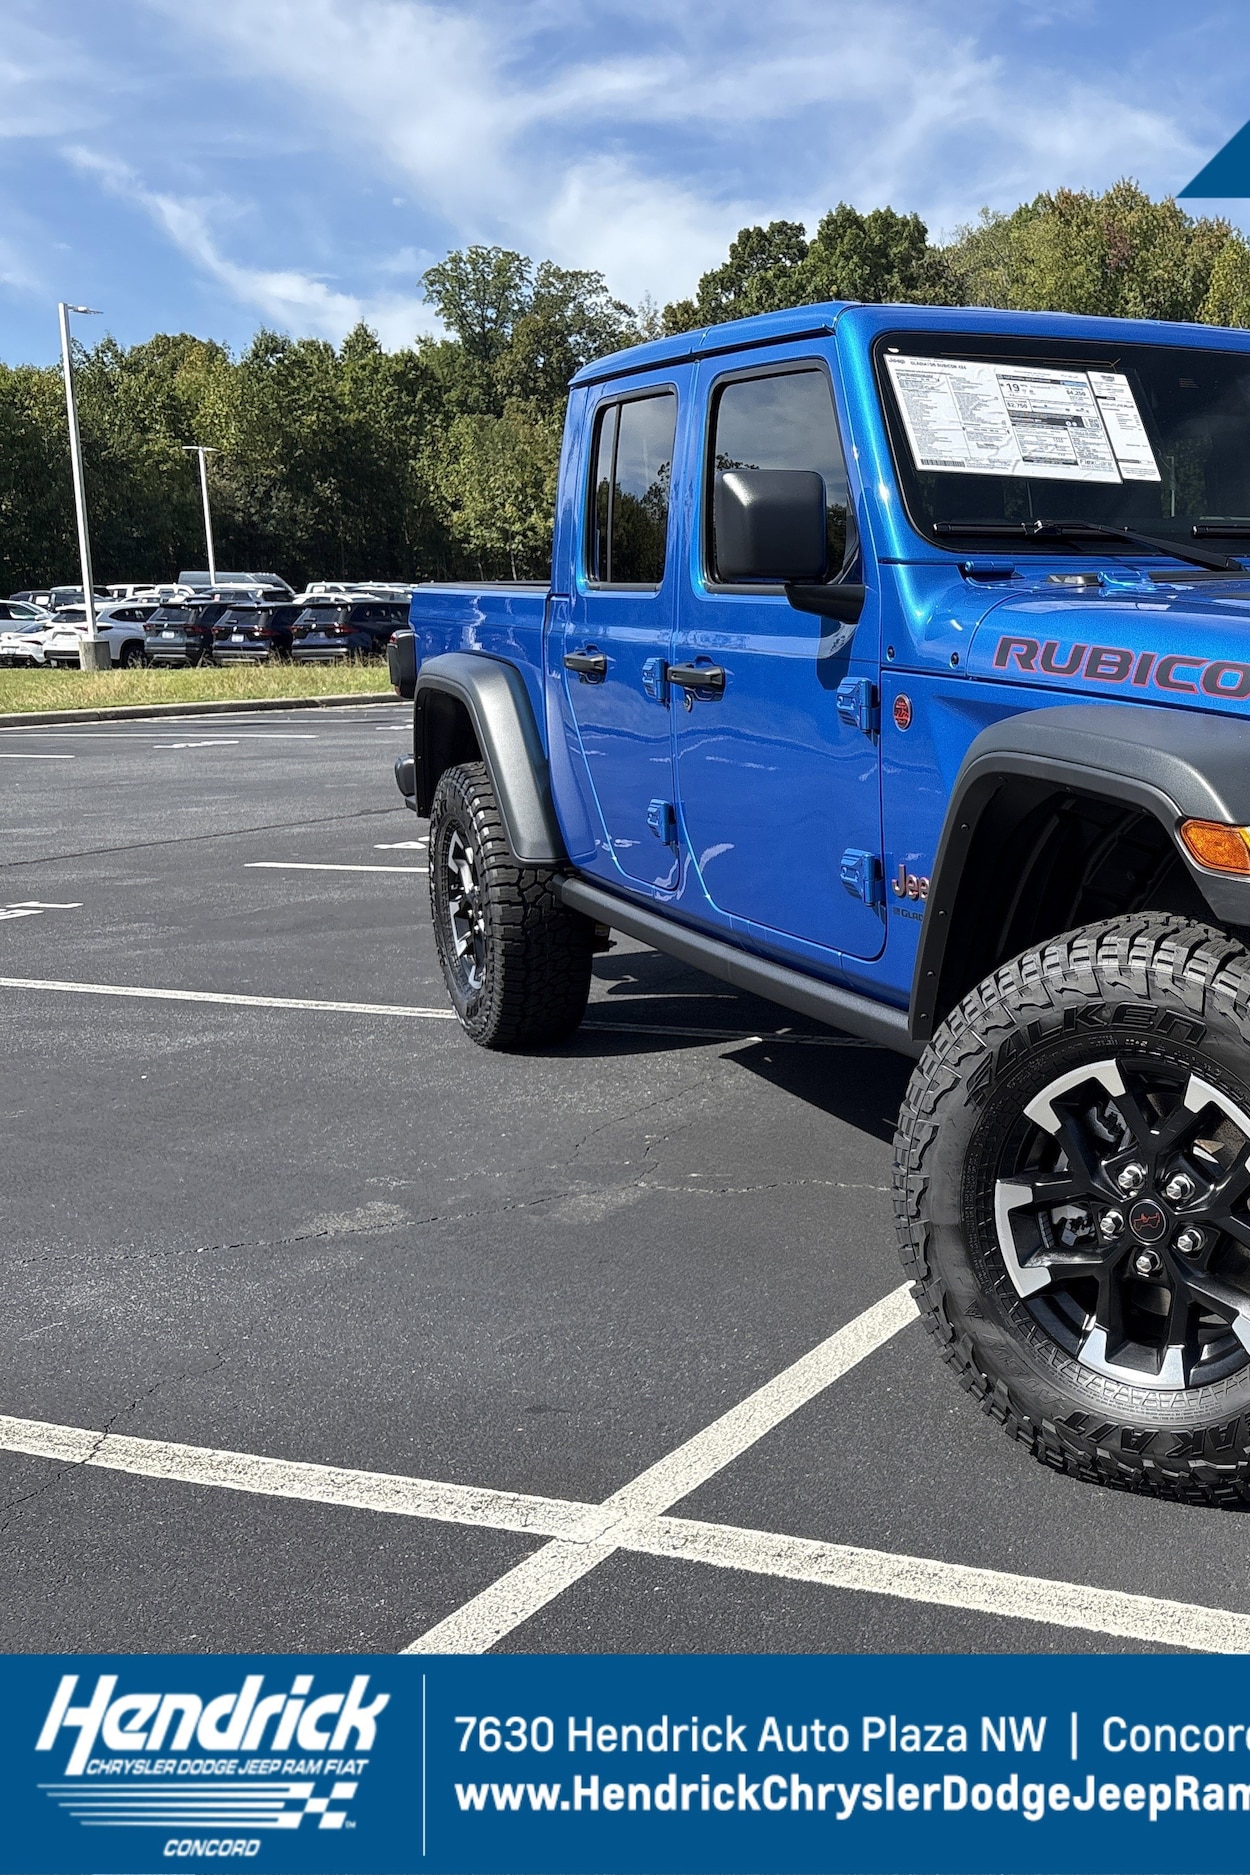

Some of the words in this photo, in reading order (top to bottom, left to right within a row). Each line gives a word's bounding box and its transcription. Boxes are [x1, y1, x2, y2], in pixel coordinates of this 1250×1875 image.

[1006, 382, 1020, 393] 19
[891, 863, 931, 901] Jee
[901, 909, 924, 922] GLAD
[964, 1001, 1207, 1107] FALKEN
